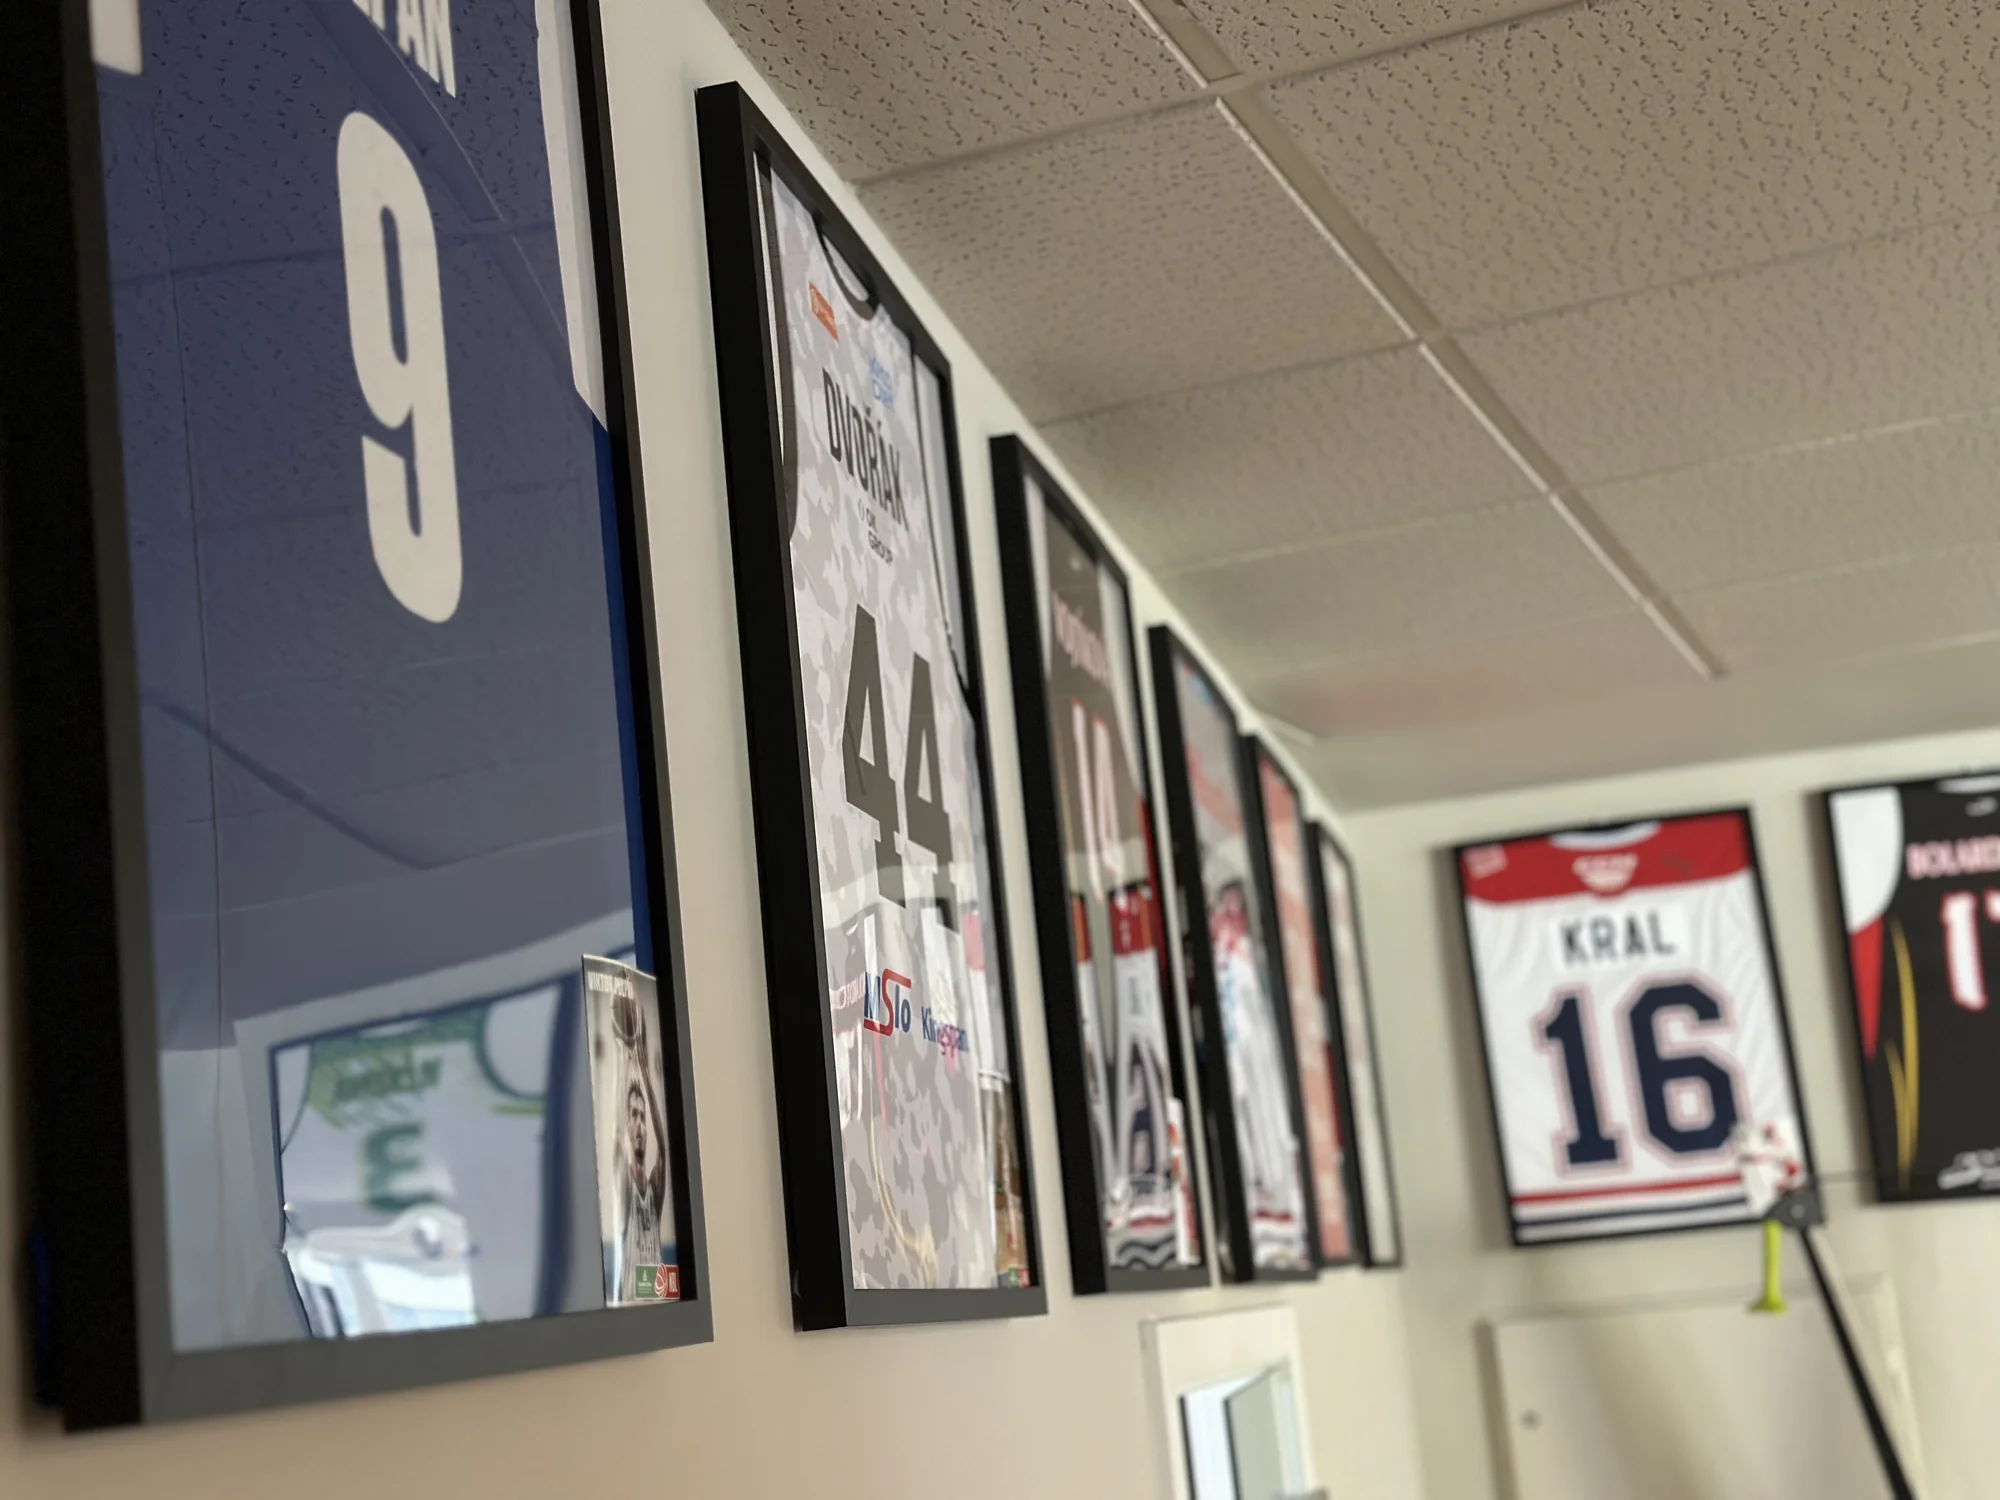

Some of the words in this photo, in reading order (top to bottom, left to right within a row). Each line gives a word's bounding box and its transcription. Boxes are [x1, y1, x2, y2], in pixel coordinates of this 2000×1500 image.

[337, 111, 463, 623] 9
[822, 366, 910, 533] DVOŘÁK
[842, 603, 960, 935] 44
[1560, 908, 1678, 968] KRAL
[1532, 974, 1748, 1178] 16
